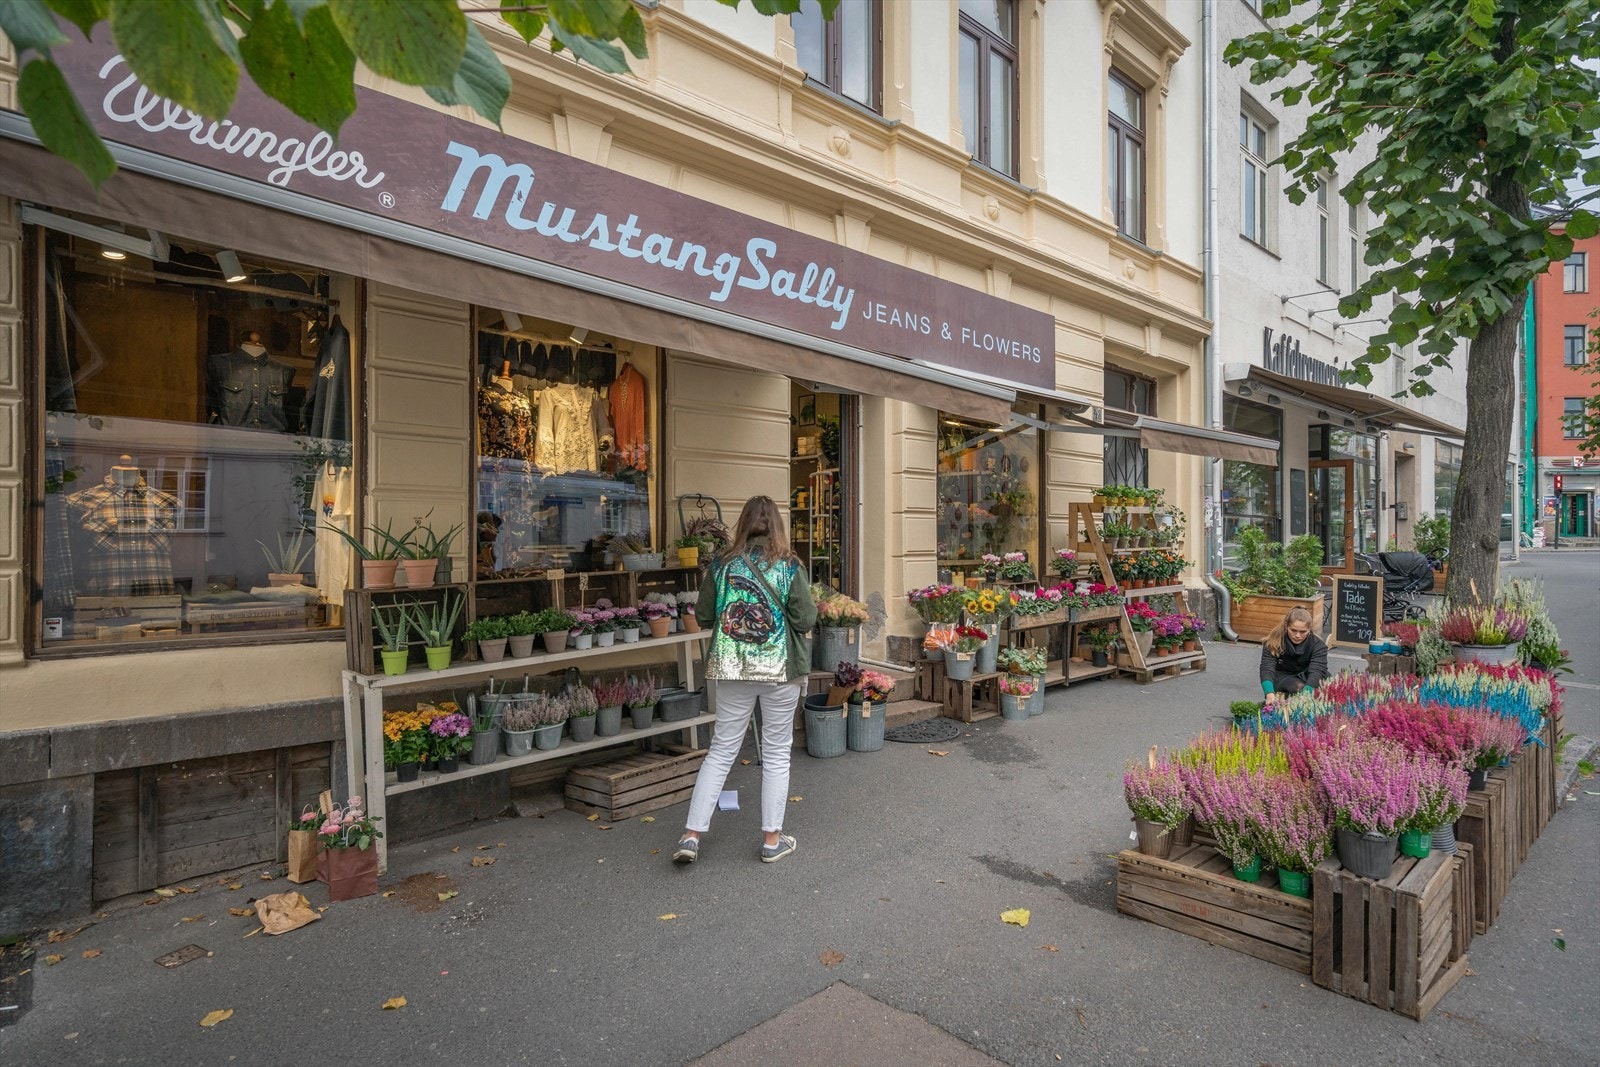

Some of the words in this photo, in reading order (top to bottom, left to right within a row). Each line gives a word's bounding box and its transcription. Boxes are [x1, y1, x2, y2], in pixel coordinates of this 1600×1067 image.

[99, 54, 385, 187] Wrangler
[862, 301, 931, 335] JEANS
[941, 322, 953, 341] &
[961, 328, 1041, 363] FLOWERS
[1342, 590, 1365, 604] Tade
